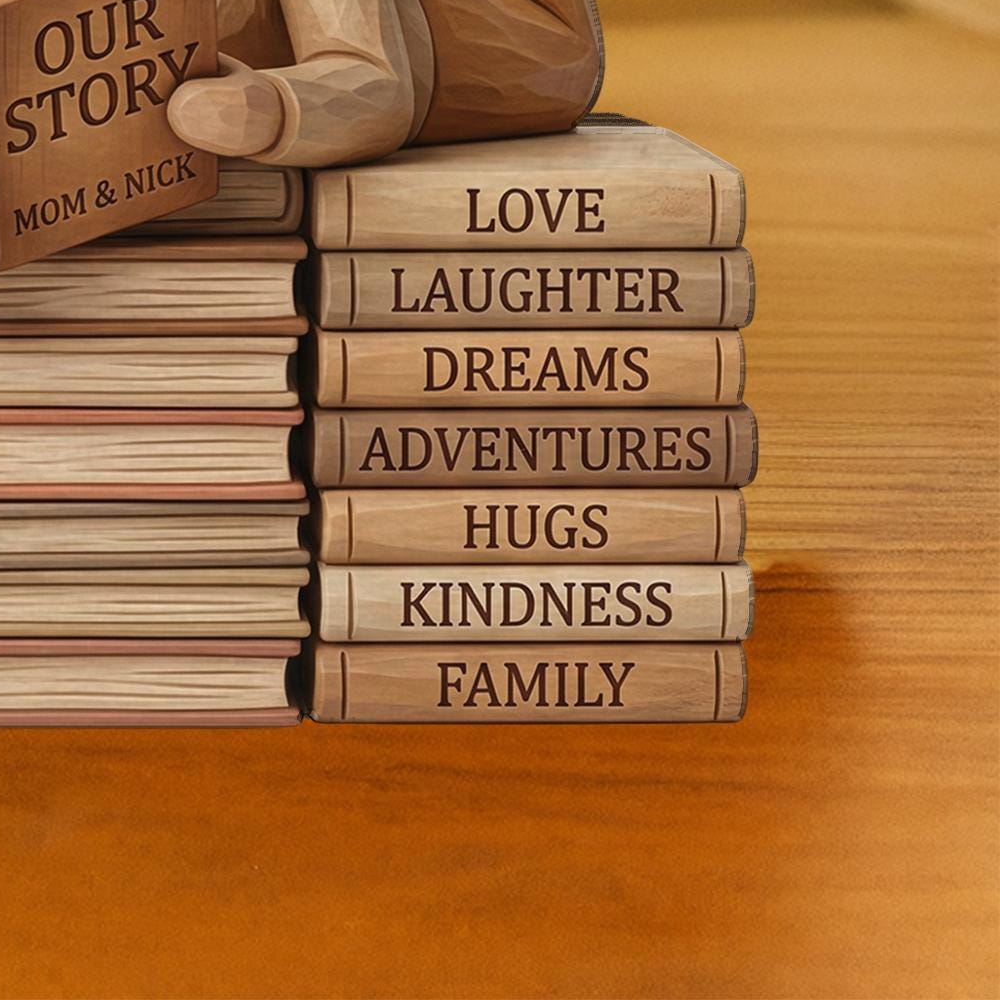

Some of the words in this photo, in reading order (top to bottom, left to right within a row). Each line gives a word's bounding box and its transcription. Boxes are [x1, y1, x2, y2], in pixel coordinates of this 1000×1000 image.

[4, 41, 199, 154] STORY
[13, 187, 87, 236] MOM
[95, 180, 118, 208] &
[124, 152, 196, 199] NICK
[466, 188, 605, 233] LOVE
[391, 268, 683, 313] LAUGHTER
[423, 346, 649, 391] DREAMS
[359, 427, 712, 472] ADVENTURES
[463, 504, 608, 549] HUGS
[400, 581, 673, 627] KINDNESS
[437, 662, 635, 707] FAMILY
